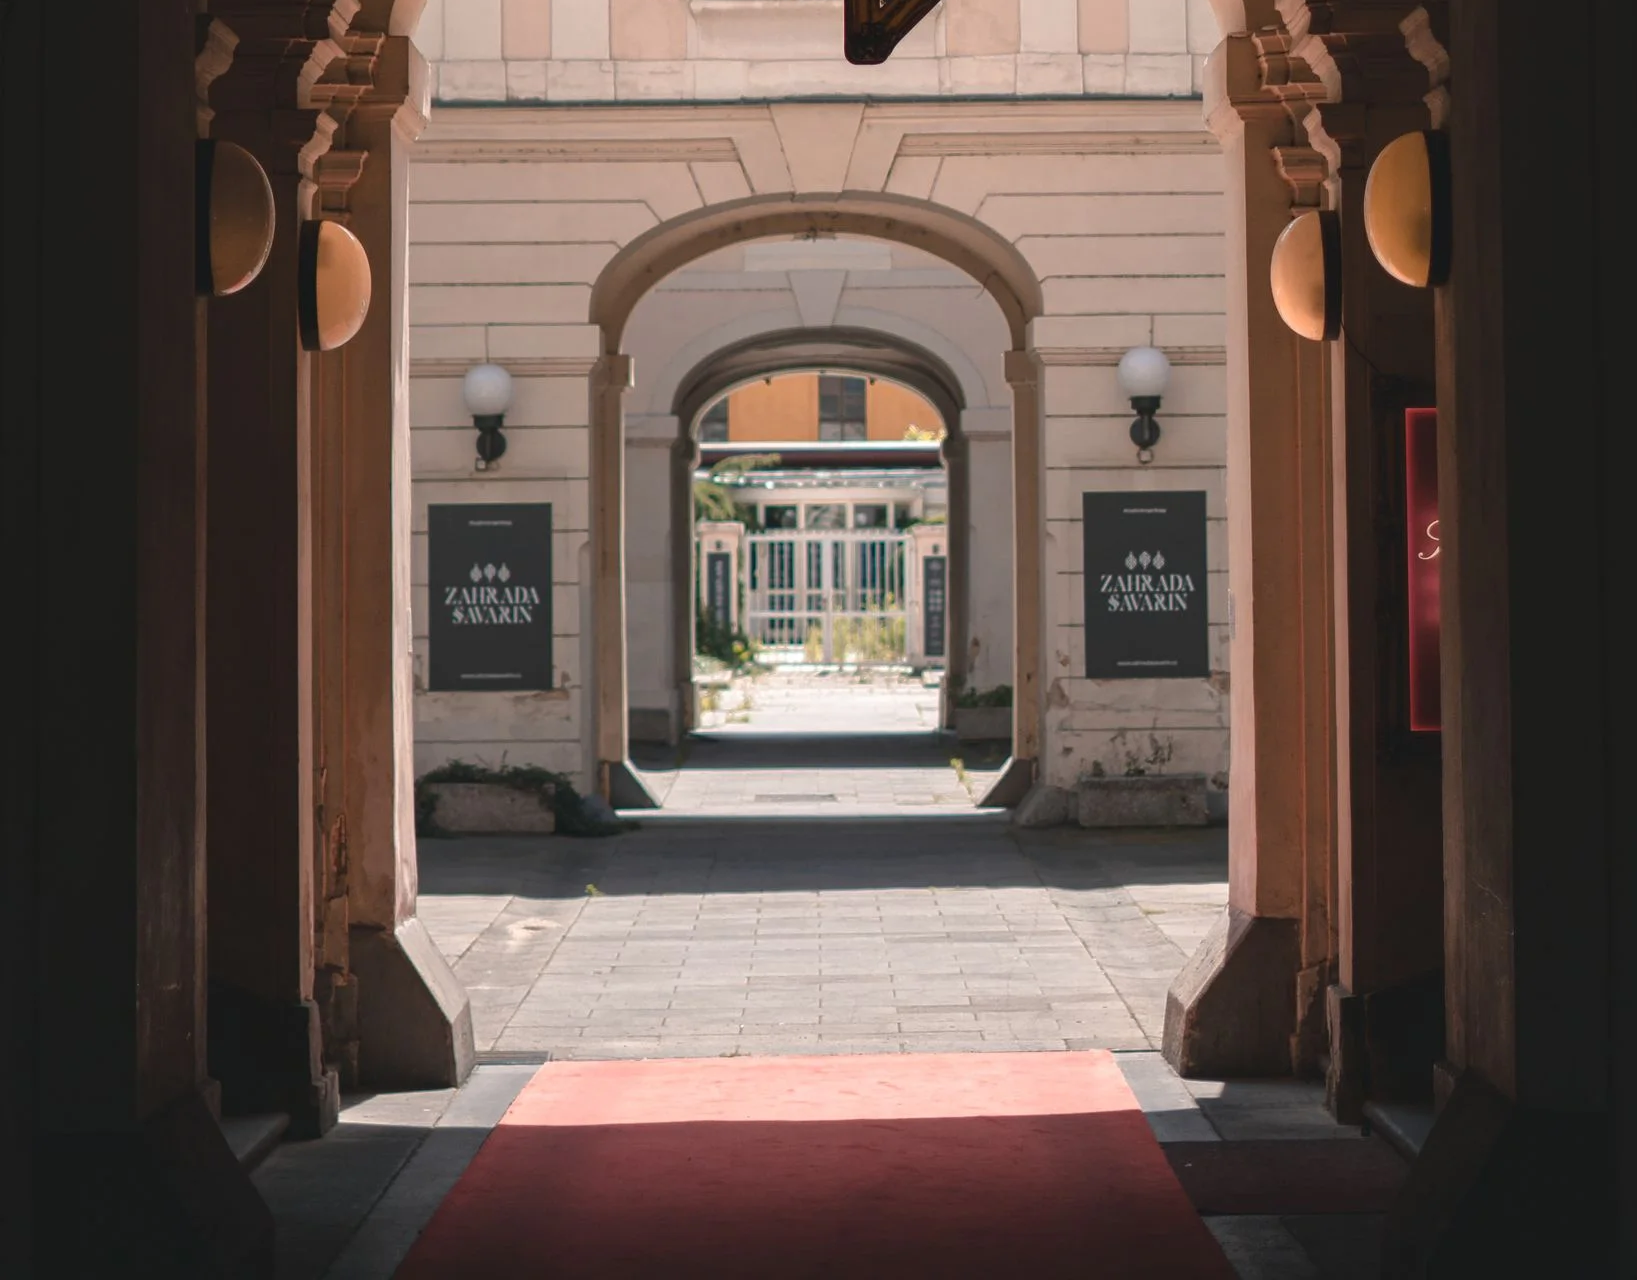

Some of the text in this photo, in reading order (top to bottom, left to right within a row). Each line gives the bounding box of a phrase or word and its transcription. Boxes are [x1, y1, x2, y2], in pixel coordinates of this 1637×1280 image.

[1100, 573, 1195, 593] ZAHRADA
[444, 585, 540, 605] ZAHRADA
[1107, 593, 1188, 612] SAVARIN
[451, 606, 533, 624] SAVARIN
